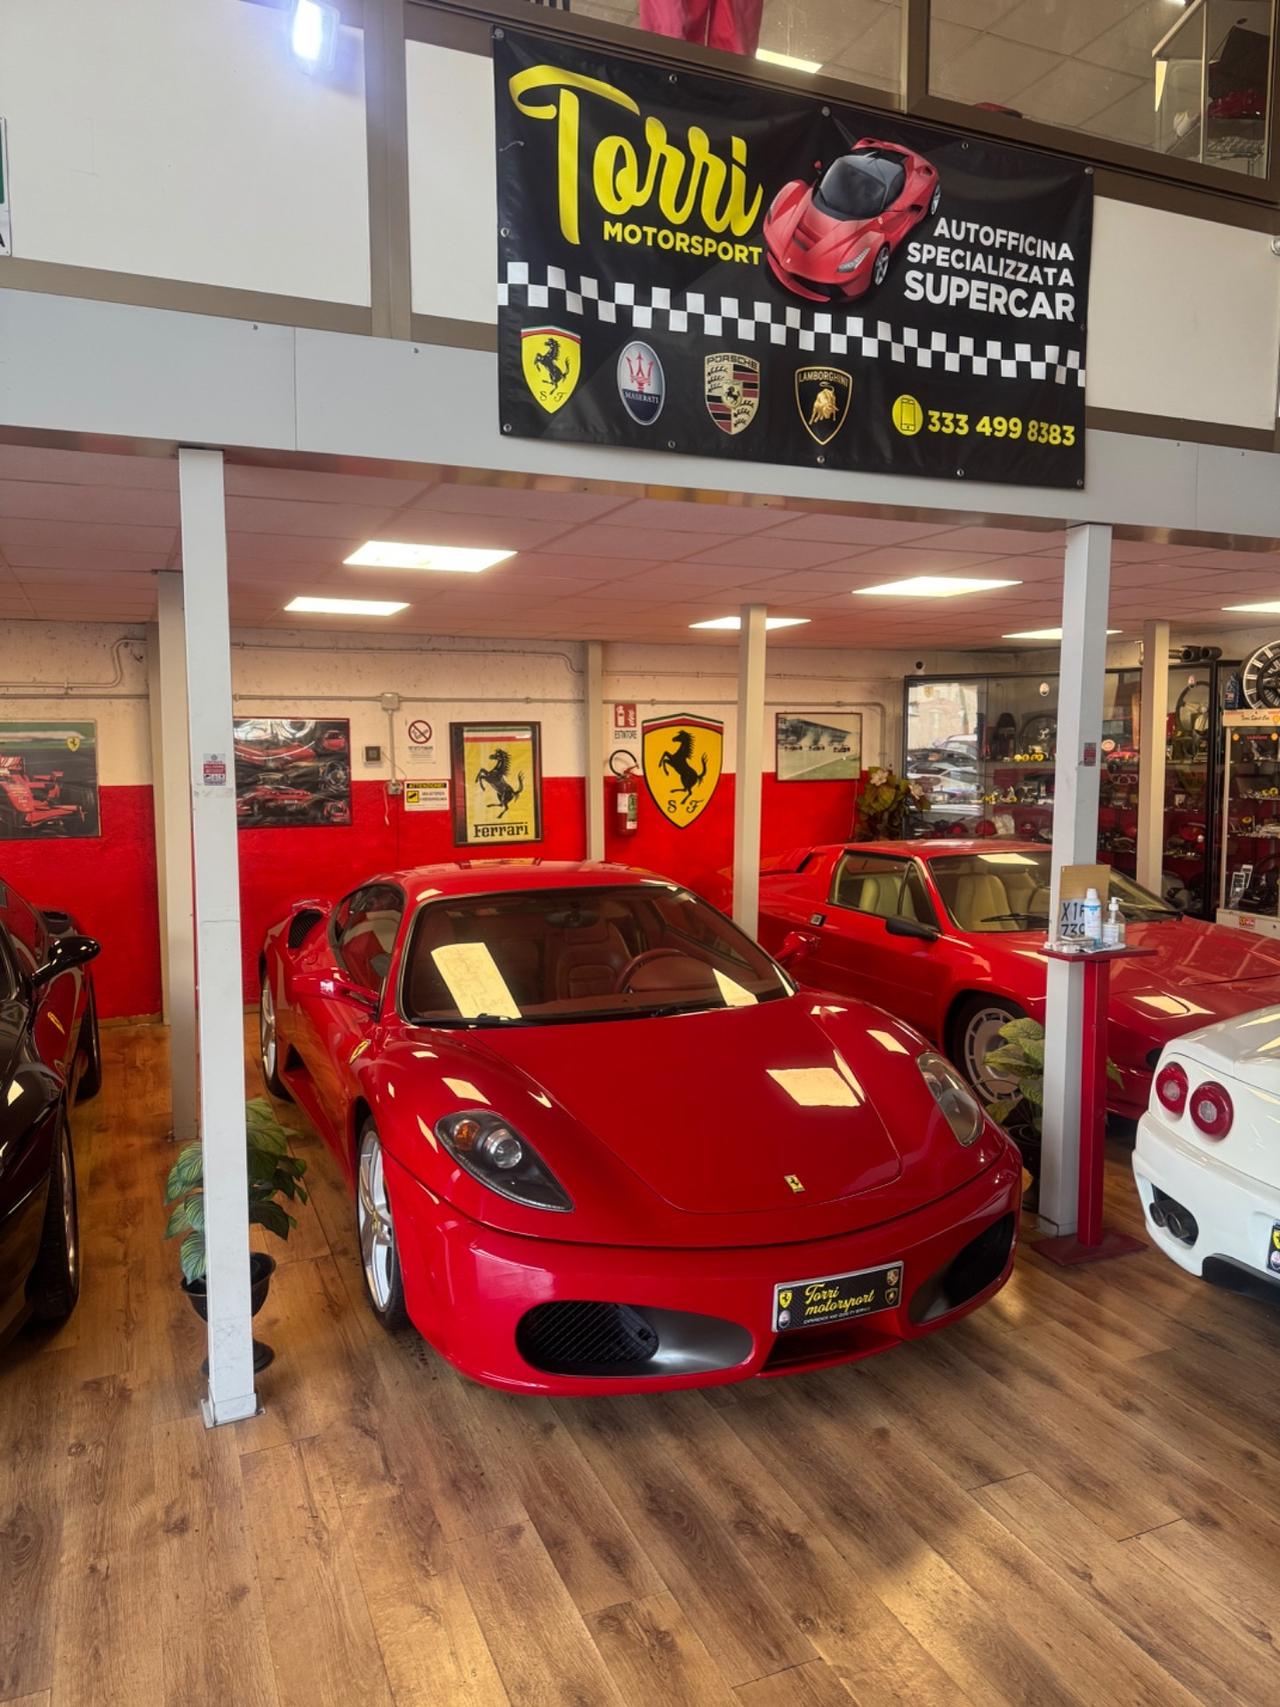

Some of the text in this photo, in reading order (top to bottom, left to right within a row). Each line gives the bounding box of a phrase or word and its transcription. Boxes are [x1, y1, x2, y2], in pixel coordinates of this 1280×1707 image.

[508, 64, 764, 245] Torri
[603, 220, 763, 265] MOTORSPORT
[933, 217, 1075, 262] AUTOFFICINA
[906, 242, 1075, 287] SPECIALIZZATA
[904, 270, 1076, 322] SUPERCAR
[706, 354, 758, 370] PORSCHE
[927, 410, 1076, 446] 333 499 8383
[667, 800, 677, 813] S
[473, 821, 529, 838] Ferrari
[804, 1282, 840, 1305] Torri
[804, 1289, 876, 1316] motorsport
